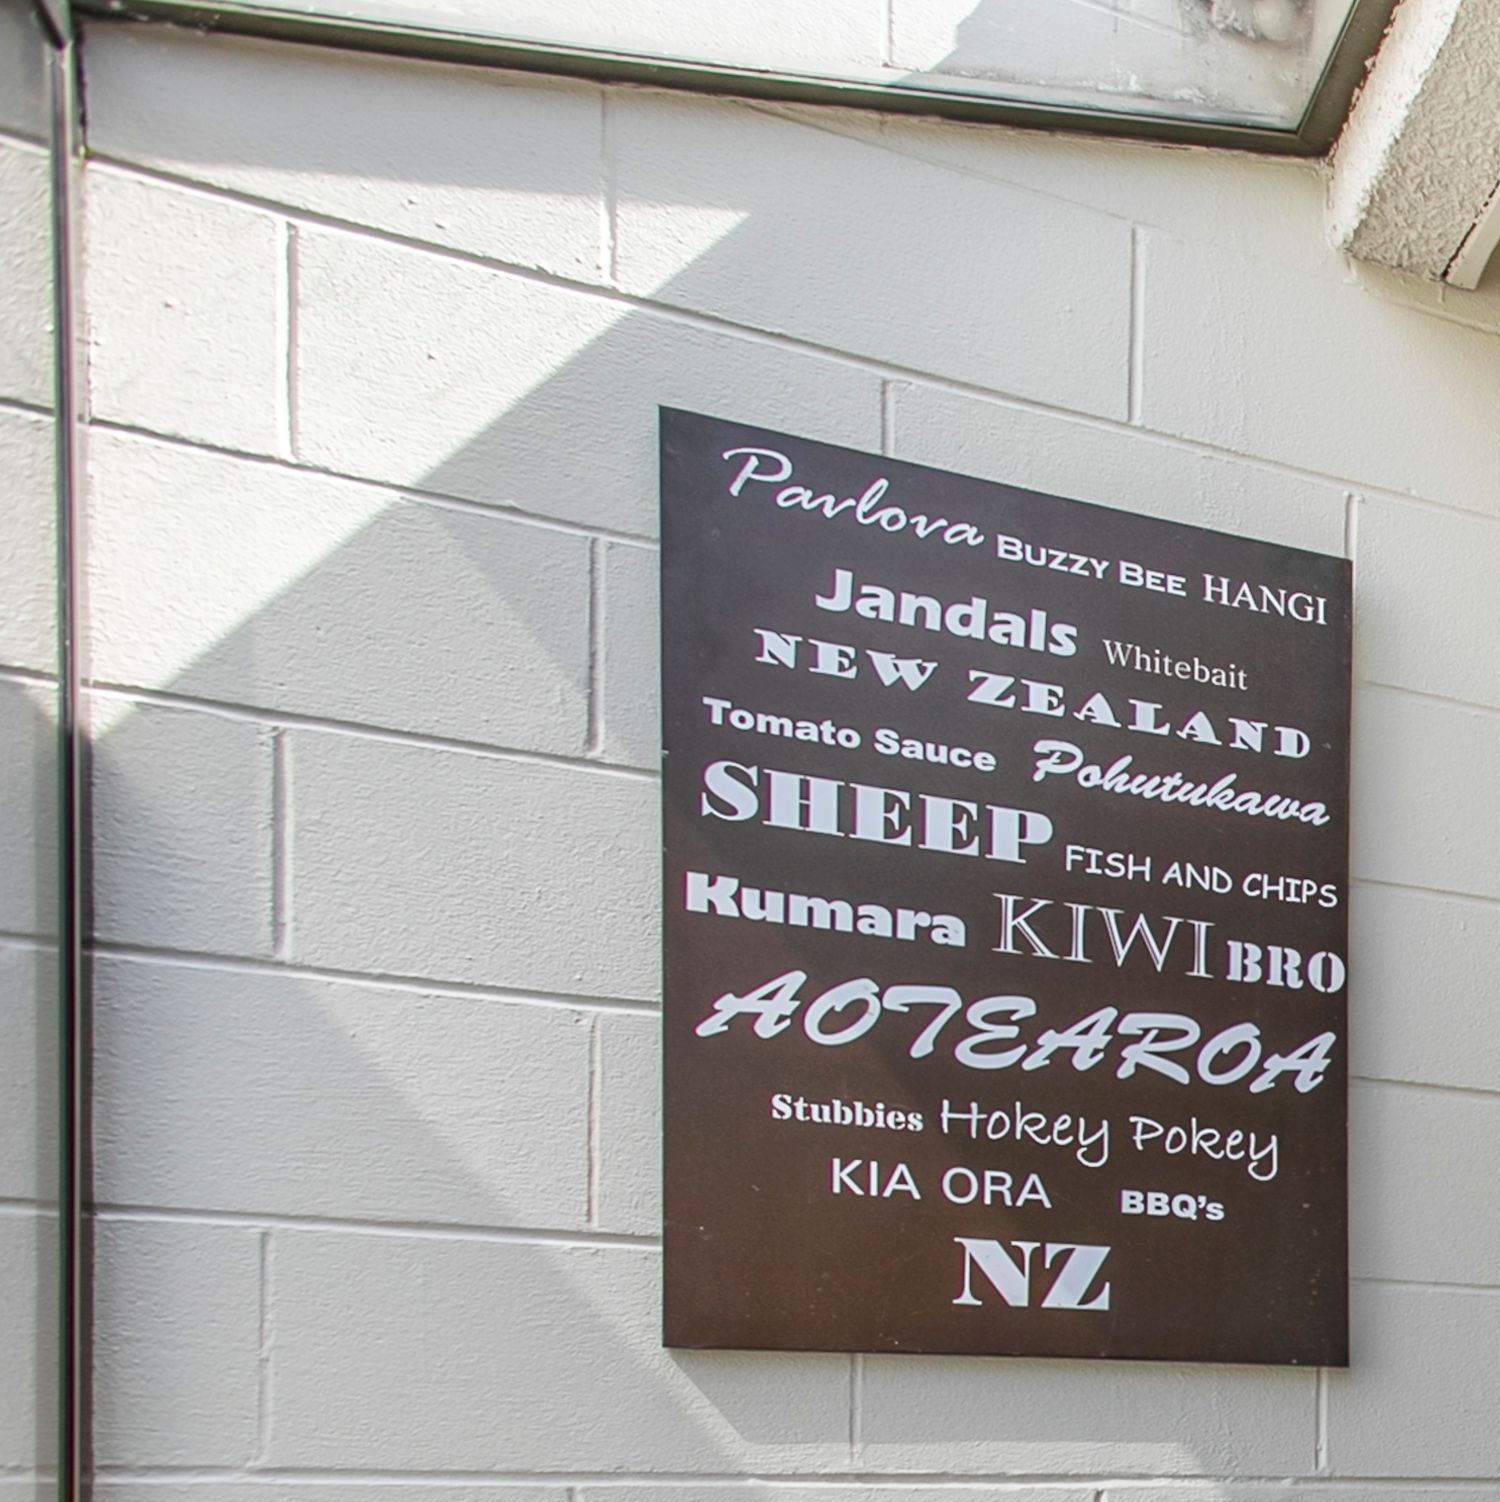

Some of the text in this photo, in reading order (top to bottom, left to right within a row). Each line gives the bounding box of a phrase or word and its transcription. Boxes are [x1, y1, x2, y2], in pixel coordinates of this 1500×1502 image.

[722, 447, 985, 546] Pavlova
[1203, 573, 1327, 625] HANGI
[815, 568, 1248, 691] Jandals Whitebait
[753, 628, 1311, 759] NEW ZEALAND
[702, 696, 1330, 826] Tomato Sauce Pohutukawa
[701, 760, 1338, 908] SHEEP FISH AND CHIPS
[686, 871, 1345, 993] Kumara KIWI BRO
[695, 970, 1336, 1094] AOTEAROA
[771, 1093, 1278, 1181] Stubbies Hokey Pokey
[832, 1157, 921, 1200] KIA
[942, 1167, 1052, 1209] ORA
[952, 1237, 1111, 1311] NZ
